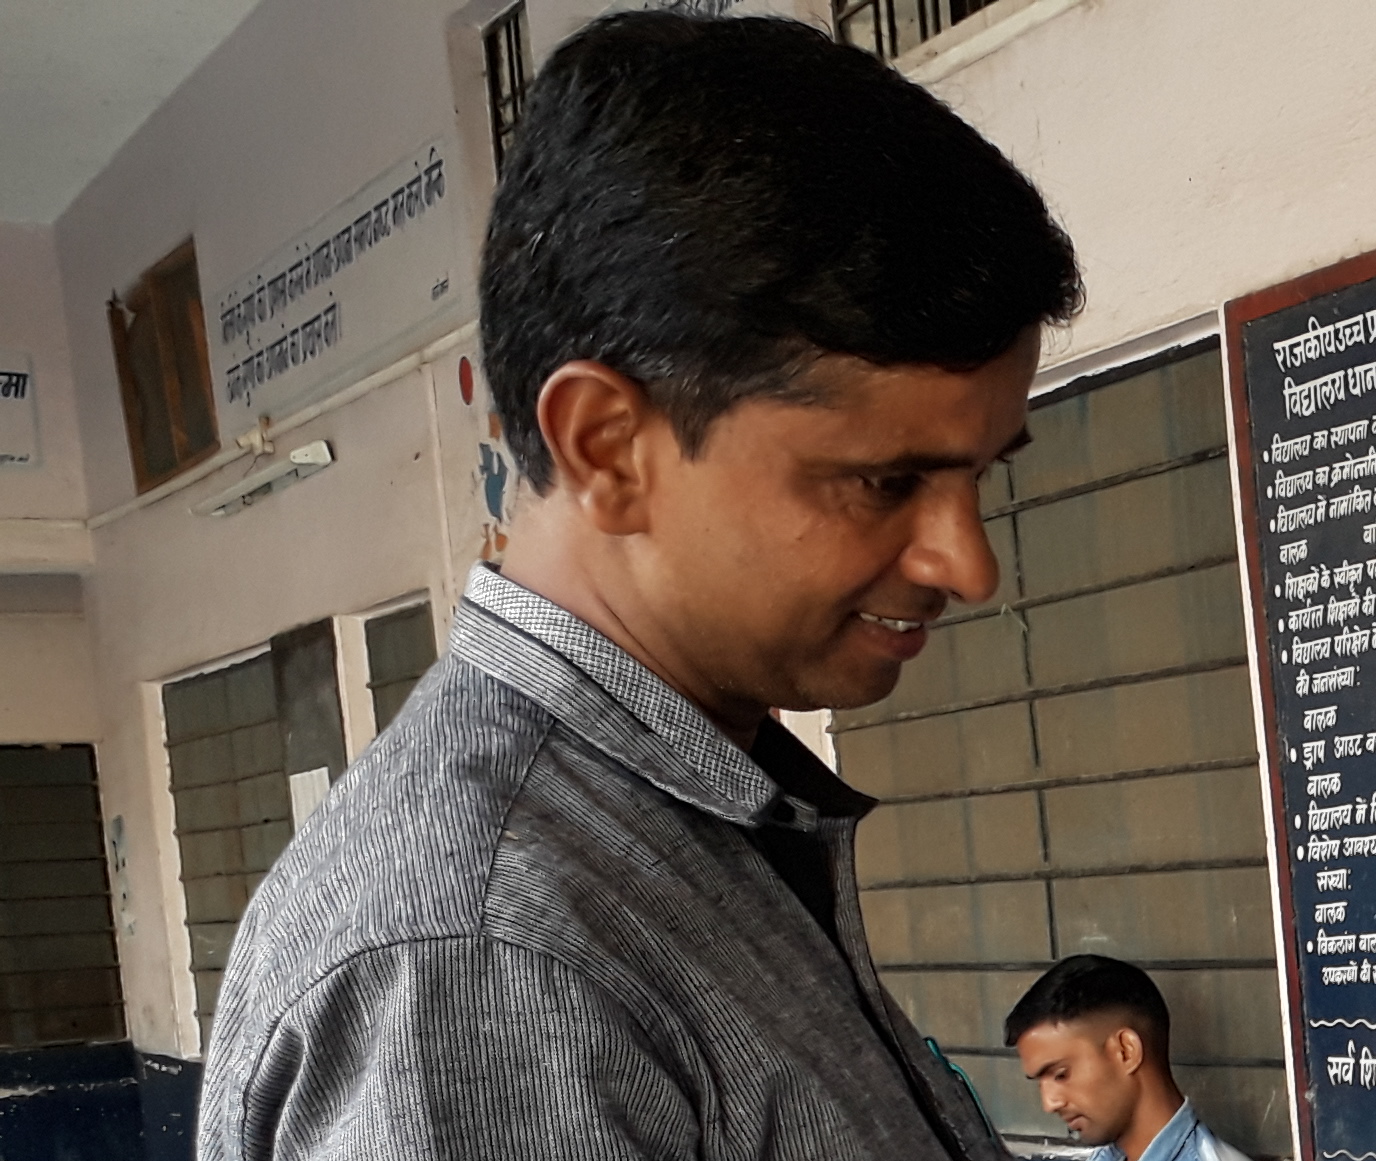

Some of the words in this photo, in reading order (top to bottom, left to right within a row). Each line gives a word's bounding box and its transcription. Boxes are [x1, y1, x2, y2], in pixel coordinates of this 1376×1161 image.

[1273, 316, 1335, 373] राजकीय
[1335, 314, 1365, 353] उच्च
[1283, 376, 1346, 420] विद्यालय
[1271, 433, 1311, 464] विद्यालय
[1313, 430, 1328, 450] का
[1330, 419, 1369, 449] स्थापना
[1275, 470, 1314, 499] विद्यालय
[1315, 466, 1329, 487] का
[1277, 504, 1316, 533] विद्यालय
[1329, 484, 1372, 519] नामांकित
[1279, 540, 1308, 565] बालक
[1320, 563, 1331, 589] के
[1288, 598, 1324, 632] कार्यरत
[1362, 586, 1376, 616] की
[1292, 636, 1332, 666] विद्यालय
[1296, 668, 1310, 698] की
[1303, 705, 1338, 732] बालक
[1307, 772, 1341, 799] बालक
[1308, 800, 1353, 832] विद्यालय
[1314, 901, 1348, 925] बालक
[1327, 1039, 1356, 1086] सर्व
